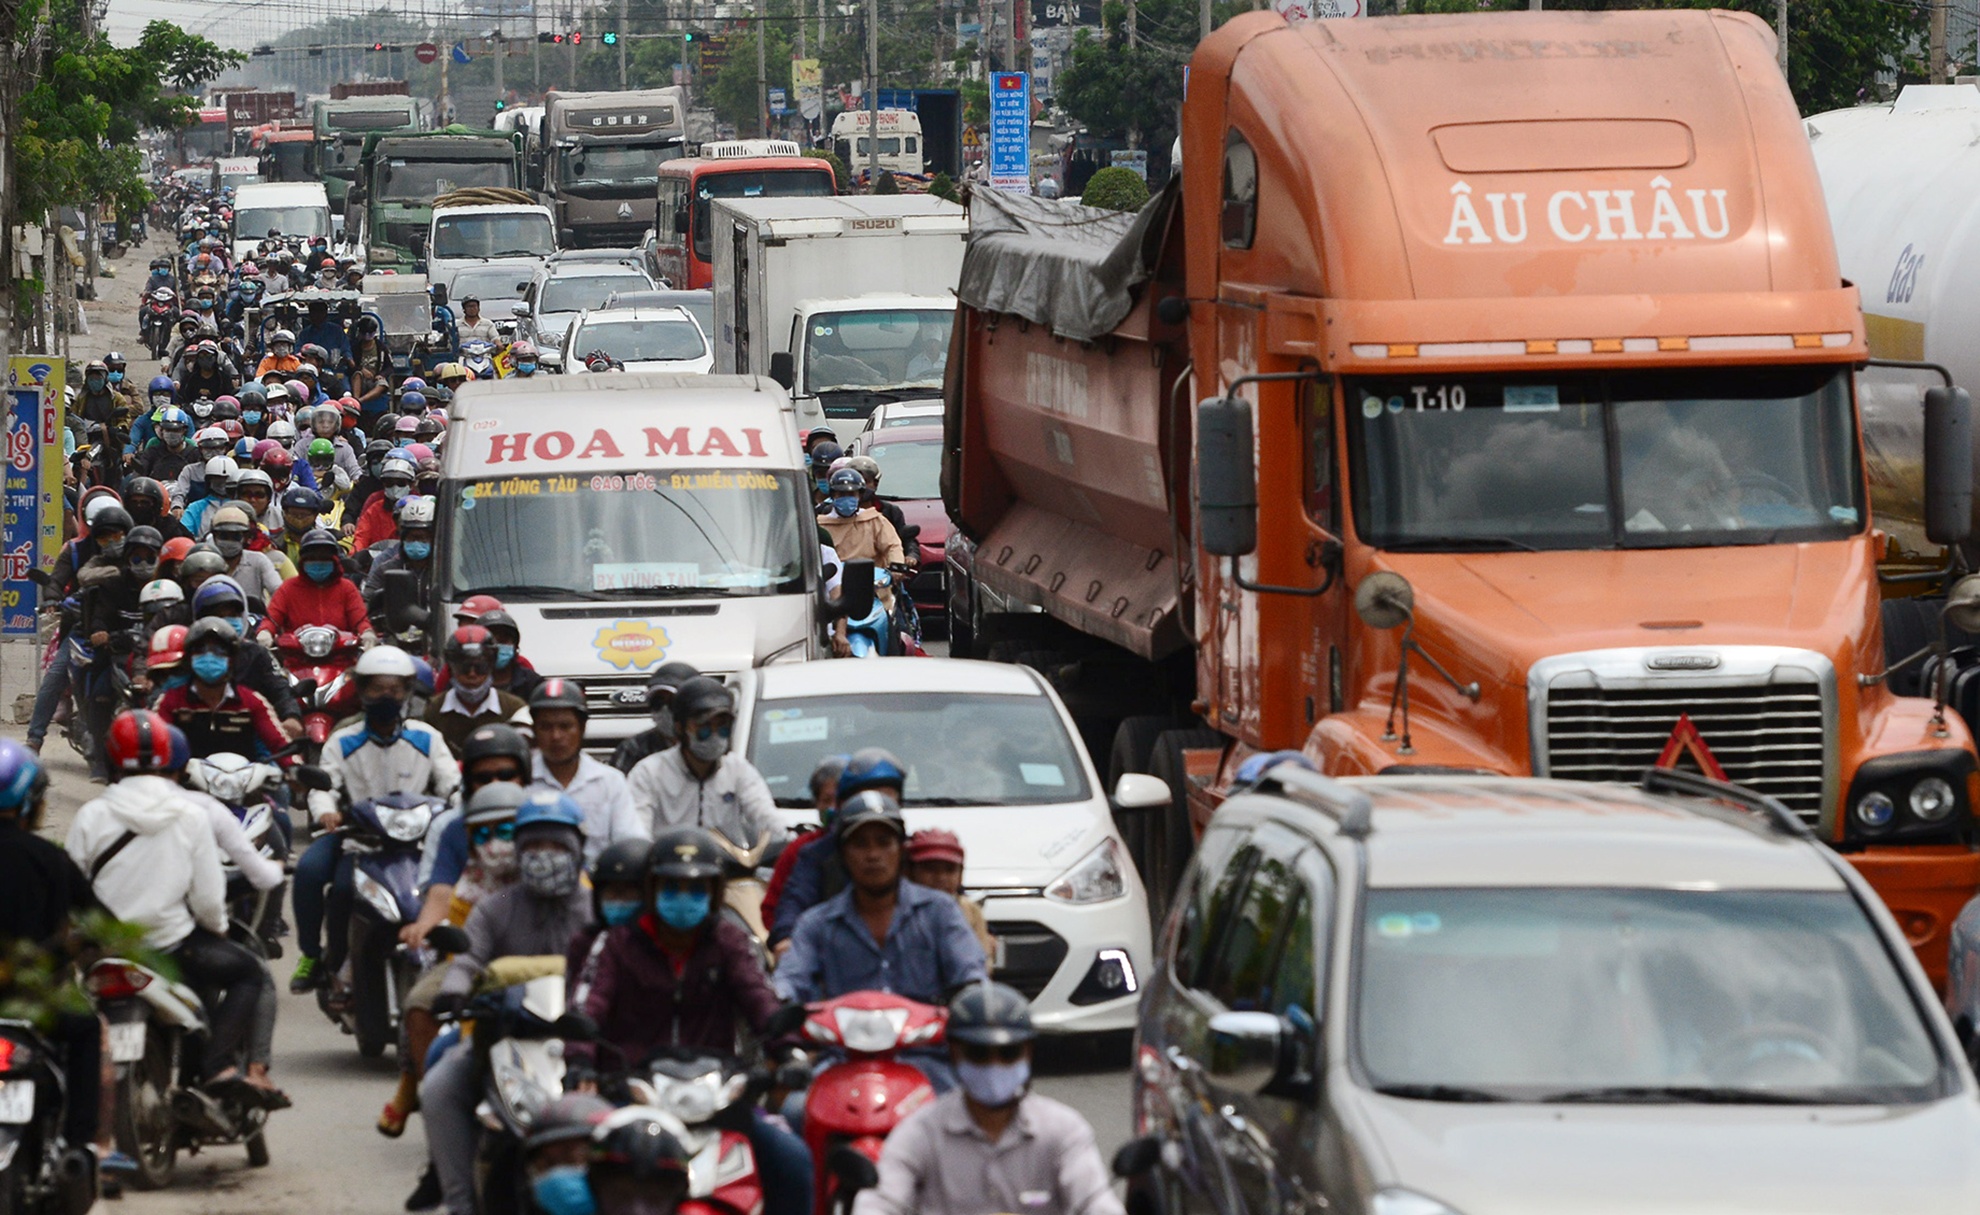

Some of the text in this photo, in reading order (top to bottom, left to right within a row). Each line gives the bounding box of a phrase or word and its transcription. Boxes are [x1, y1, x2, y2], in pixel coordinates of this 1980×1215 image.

[852, 220, 896, 230] ISUZU
[1443, 175, 1731, 244] ÂU CHÂU
[1886, 243, 1925, 303] Gas
[485, 427, 769, 464] HOA MAI
[547, 475, 578, 493] TÀU
[591, 475, 623, 491] CAO
